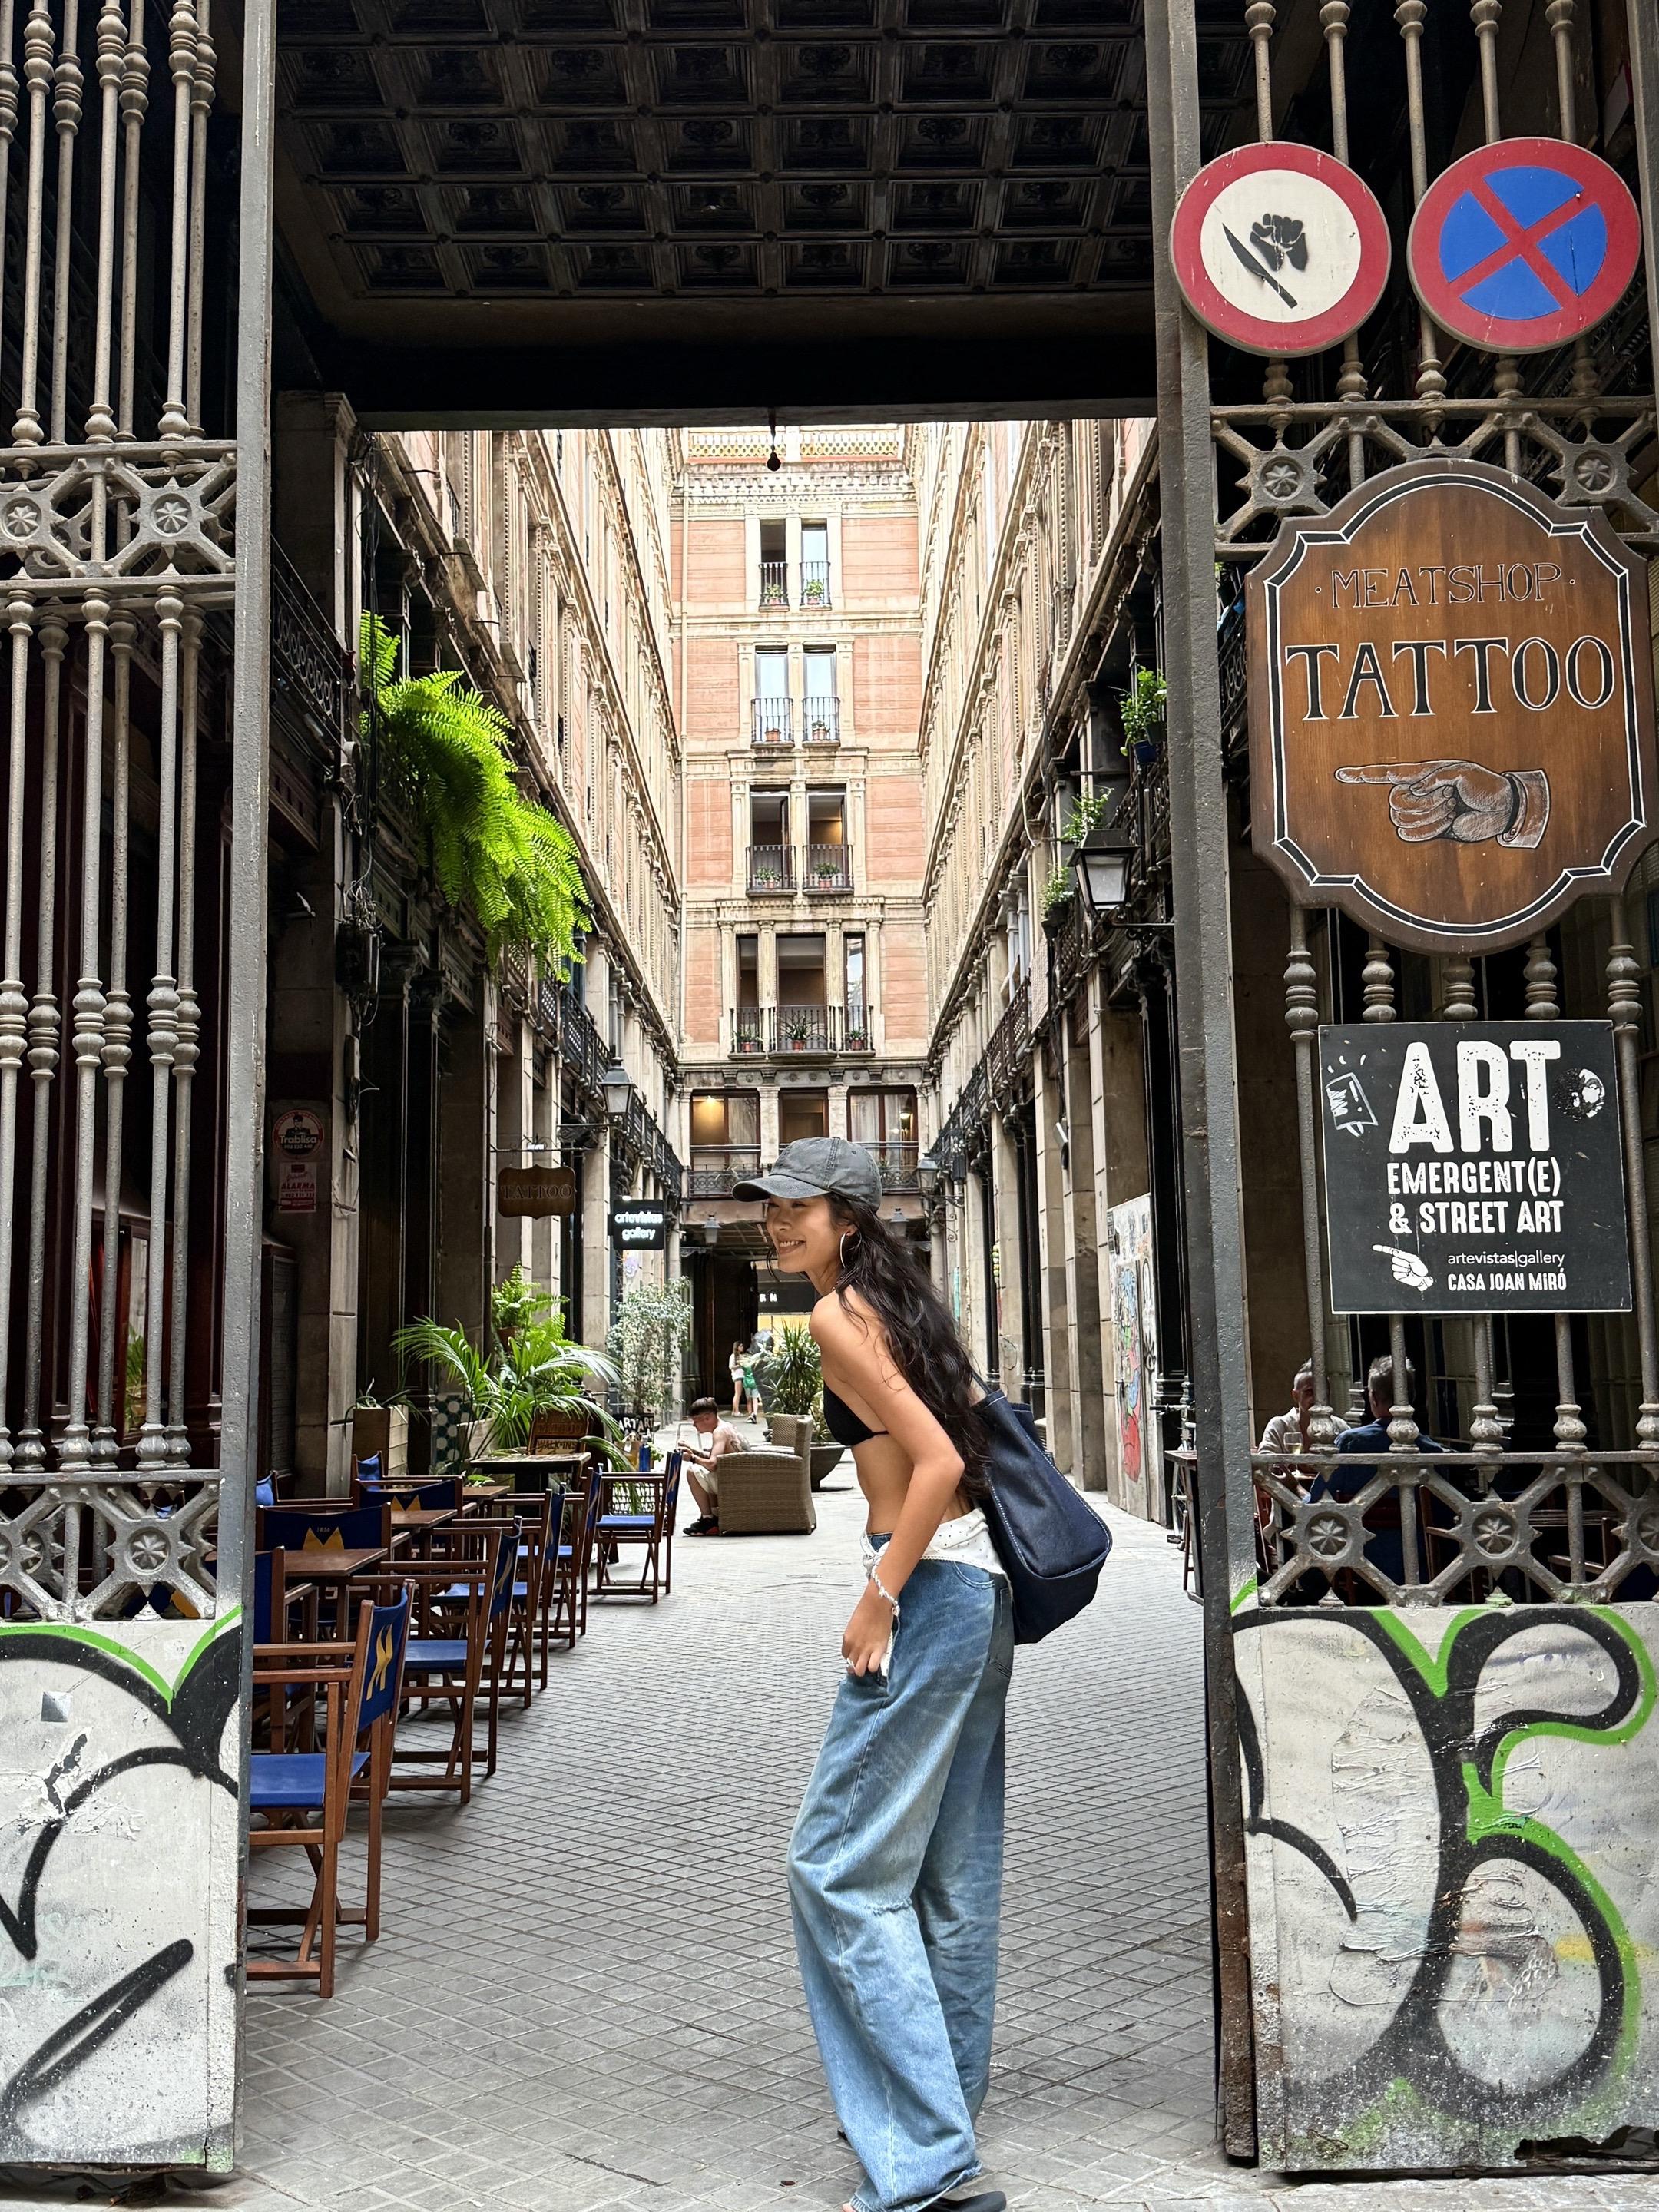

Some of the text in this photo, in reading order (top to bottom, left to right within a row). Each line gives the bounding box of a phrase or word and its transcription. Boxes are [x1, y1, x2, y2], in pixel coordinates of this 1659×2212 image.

[1331, 562, 1561, 608] MEATSHOP
[1284, 635, 1614, 721] TATTOO
[1388, 1040, 1561, 1154] ART
[279, 1134, 317, 1144] Trablisa
[500, 1184, 573, 1200] TATTOO
[1386, 1157, 1561, 1197] EMERGENT(E)
[622, 1227, 656, 1240] gallery
[1389, 1201, 1564, 1234] & STREET ART
[1448, 1267, 1567, 1291] CASA JOAN MIRÓ
